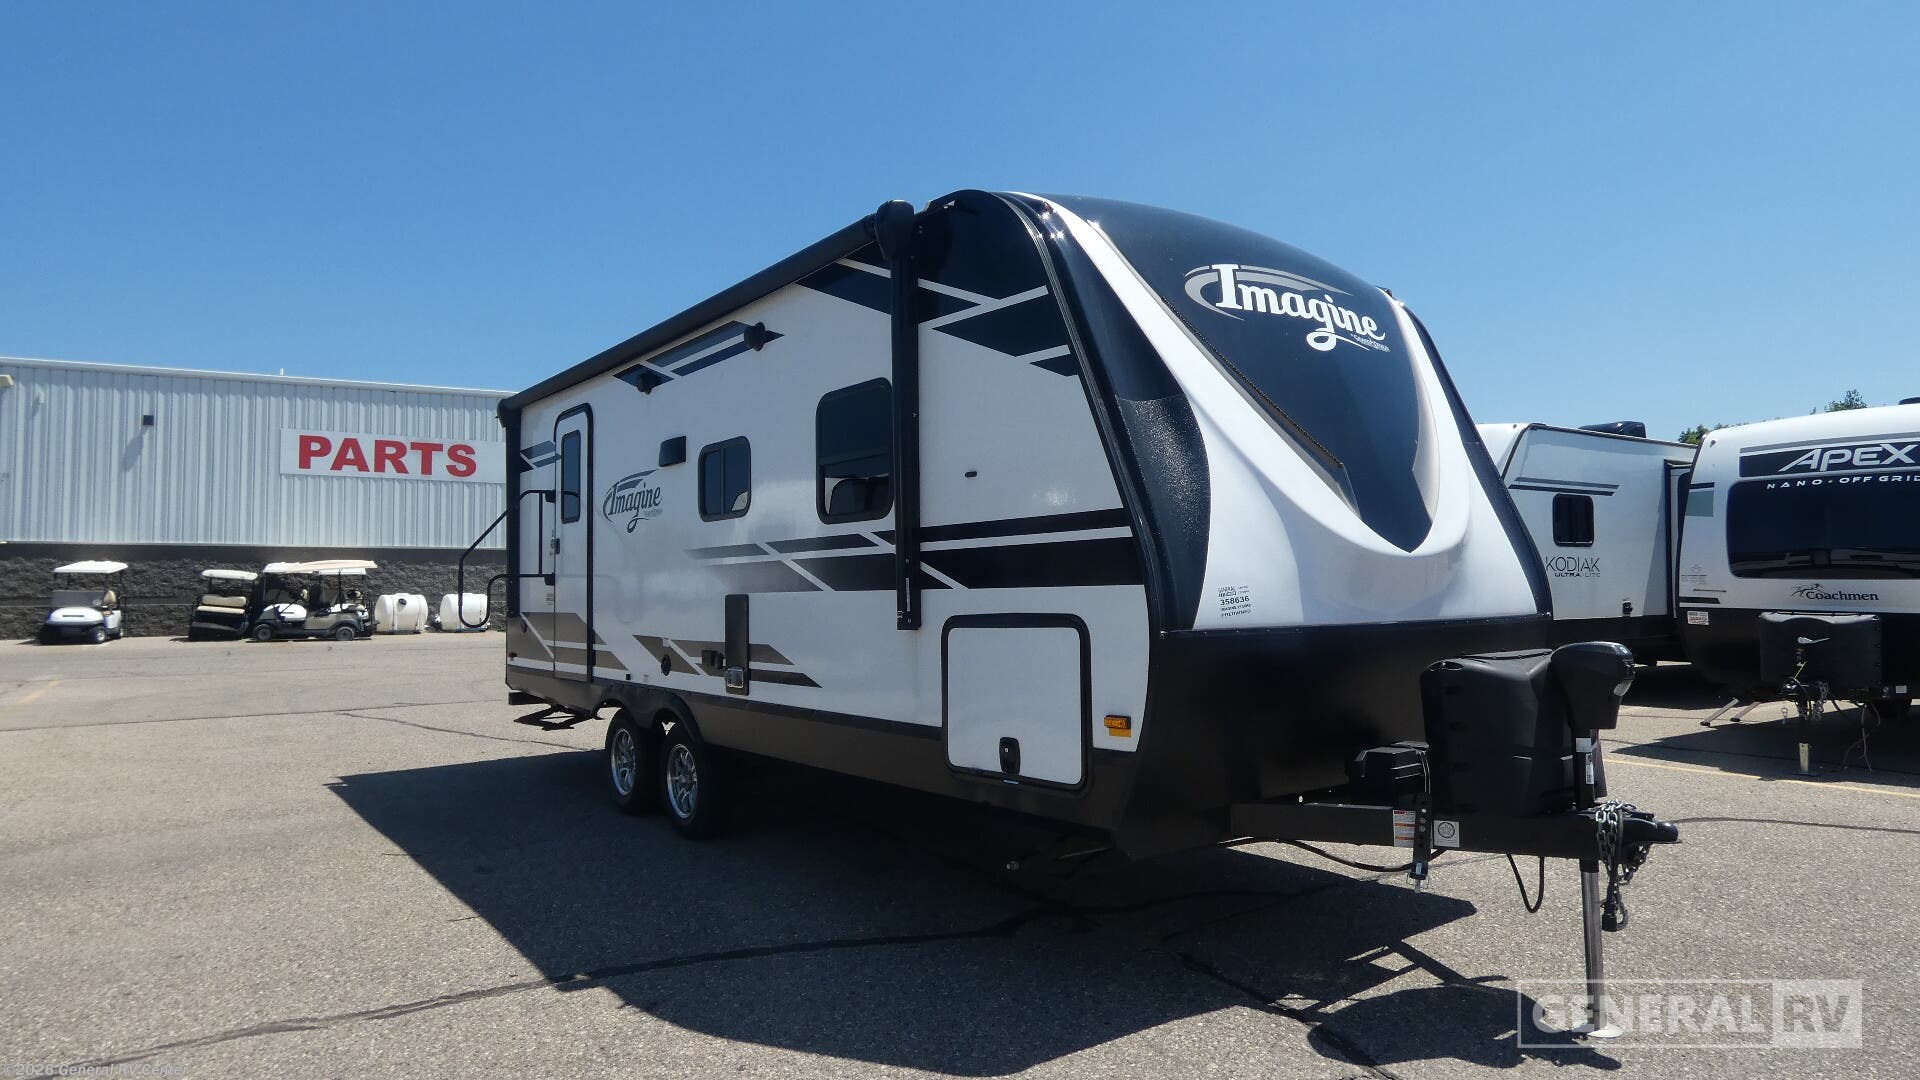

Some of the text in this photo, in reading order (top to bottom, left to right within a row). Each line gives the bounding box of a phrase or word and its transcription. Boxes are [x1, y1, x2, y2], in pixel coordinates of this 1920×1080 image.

[1211, 263, 1386, 351] Imagine
[298, 434, 477, 478] PARTS
[1777, 443, 1918, 472] APEX
[1766, 479, 1823, 490] NANO
[1839, 476, 1872, 484] OFF
[607, 482, 661, 533] Imagine
[1545, 556, 1600, 572] KODIAK
[1220, 595, 1250, 606] 358636
[1806, 590, 1879, 600] Coachmen
